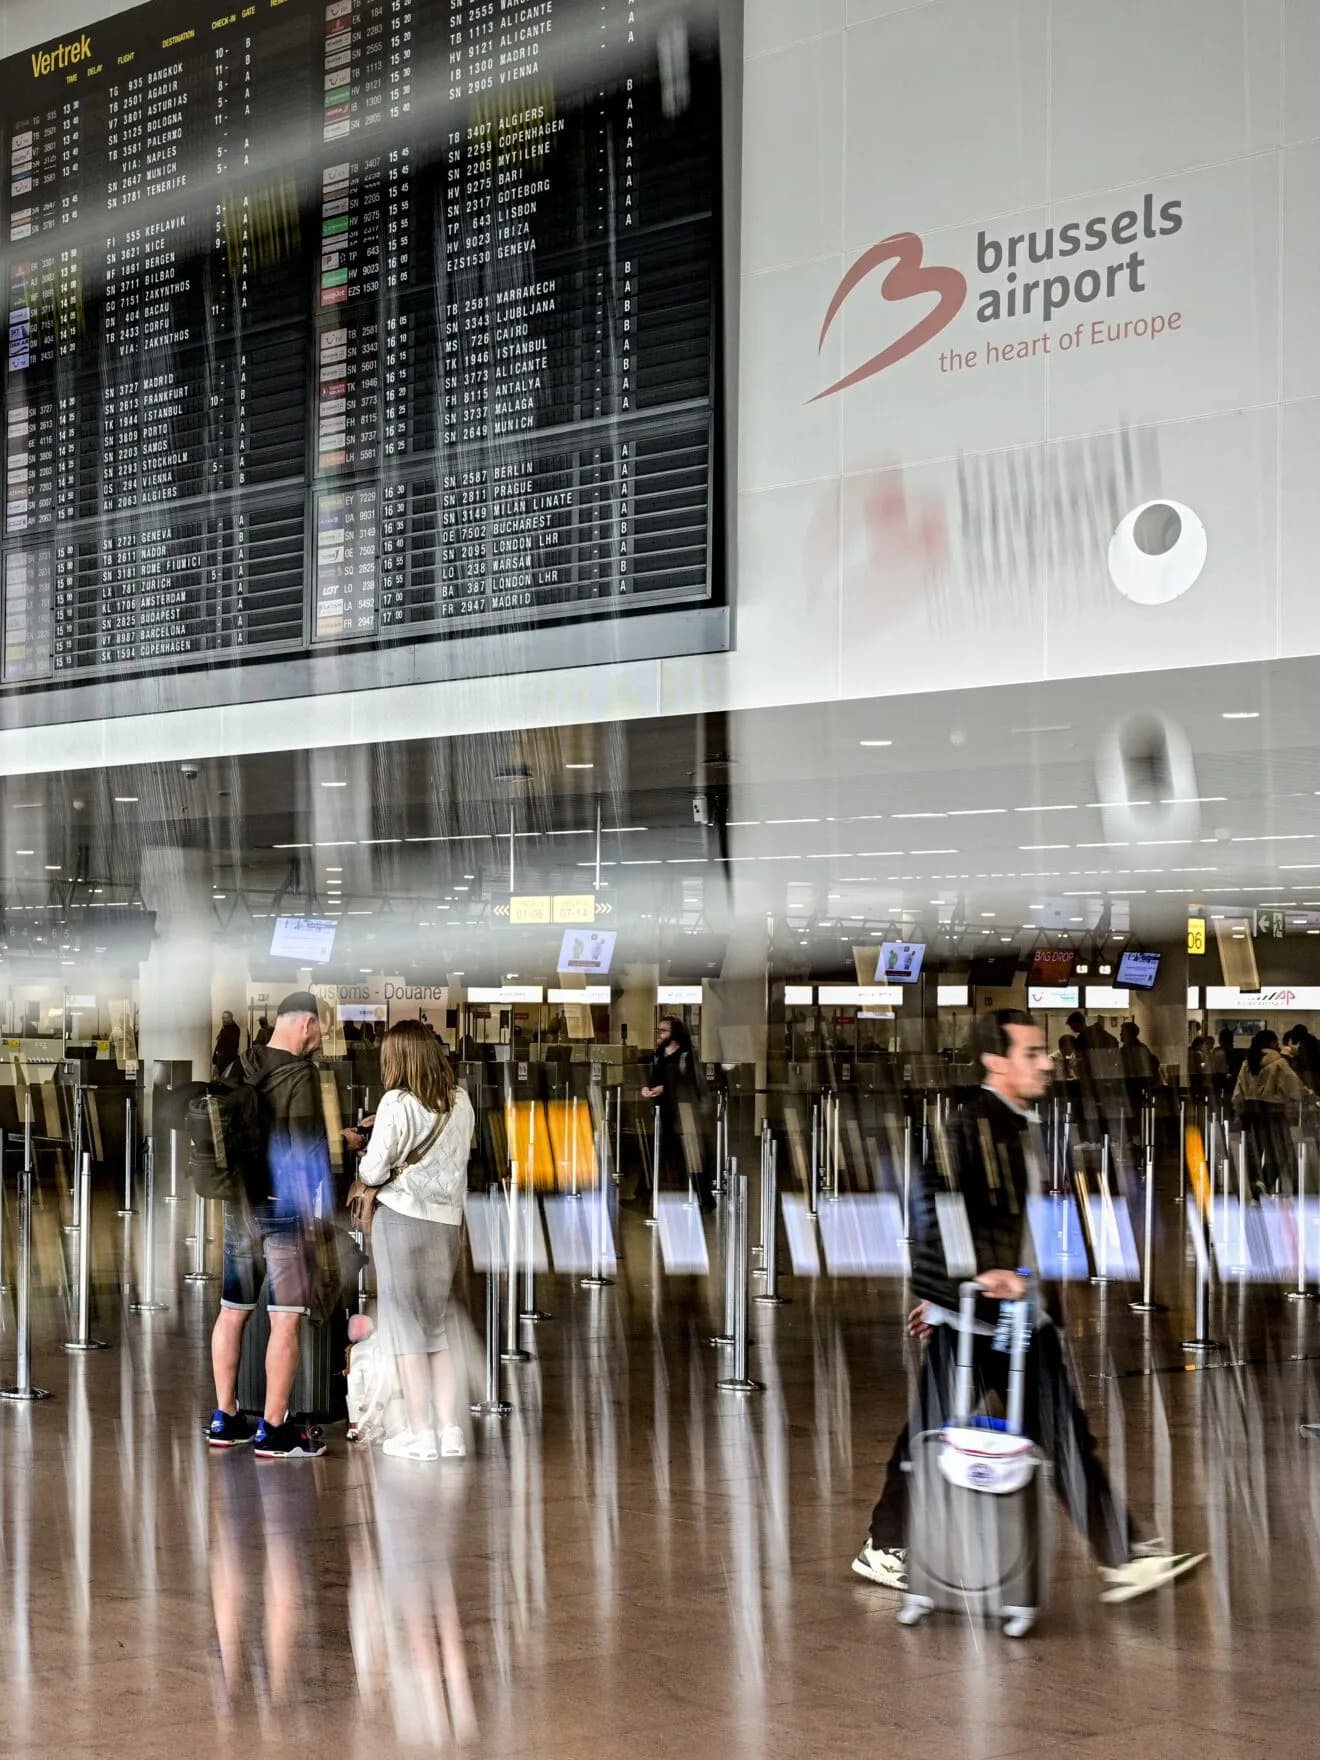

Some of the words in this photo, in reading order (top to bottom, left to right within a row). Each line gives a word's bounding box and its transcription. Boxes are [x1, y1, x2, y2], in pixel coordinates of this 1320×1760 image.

[500, 1, 552, 29] ALICANTE
[500, 20, 552, 48] ALICANTE
[32, 33, 91, 78] Vertrek
[66, 73, 77, 85] TIME
[87, 64, 103, 76] DELAY
[118, 52, 135, 65] FLIGHT
[162, 29, 195, 48] DESTINATION
[212, 14, 236, 30] CHECK-IN
[242, 6, 256, 19] GATE
[500, 43, 539, 66] MADRID
[148, 62, 183, 84] BANGKOK
[499, 61, 538, 85] VIENNA
[148, 81, 178, 99] AGADIR
[147, 93, 187, 116] ASTURIAS
[147, 113, 183, 132] BOLOGNA
[499, 105, 544, 131] ALGIERS
[147, 129, 182, 148] PALERMO
[499, 118, 565, 148] COPENHAGEN
[122, 154, 141, 173] VIA:
[147, 145, 177, 165] NAPLES
[498, 141, 550, 168] MYTILENE
[147, 162, 177, 180] MUNICH
[498, 171, 522, 186] BARI
[146, 175, 186, 197] TENERIFE
[498, 179, 550, 205] GOTEBORG
[498, 201, 536, 223] LISBON
[145, 216, 185, 236] KEFLAVIK
[498, 221, 529, 239] IBIZA
[977, 194, 1184, 274] brussels
[145, 238, 165, 253] NICE
[497, 239, 536, 260] GENEVA
[145, 251, 175, 269] BERGEN
[145, 268, 175, 285] BILBAO
[145, 279, 190, 302] ZAKYNTHOS
[497, 280, 555, 304] MARRAKECH
[976, 251, 1145, 324] airport
[145, 302, 169, 318] BACAU
[497, 298, 555, 323] LJUBLJANA
[145, 318, 169, 334] CORFU
[497, 323, 528, 341] CAIRO
[120, 342, 138, 356] VIA:
[144, 328, 189, 350] ZAKYNTHOS
[496, 337, 547, 359] ISTANBUL
[938, 348, 978, 373] the
[986, 333, 1050, 366] heart
[1058, 324, 1084, 351] of
[1091, 311, 1182, 345] Europe
[496, 356, 547, 379] ALICANTE
[144, 373, 174, 390] MADRID
[495, 377, 541, 397] ANTALYA
[144, 386, 189, 406] FRANKFURT
[144, 404, 183, 422] ISTANBUL
[495, 397, 533, 416] MALAGA
[143, 424, 168, 439] PORTO
[495, 415, 533, 433] MUNICH
[143, 439, 168, 455] SAMOS
[143, 452, 188, 471] STOCKHOLM
[143, 471, 172, 487] VIENNA
[444, 476, 456, 489] SN
[463, 470, 487, 485] 2587
[495, 461, 533, 479] BERLIN
[142, 486, 177, 503] ALGIERS
[443, 494, 455, 507] SN
[462, 489, 486, 503] 2811
[494, 480, 532, 498] PRAGUE
[443, 513, 455, 525] SN
[462, 507, 486, 522] 3149
[493, 501, 526, 517] MILAN
[533, 492, 572, 511] LINATE
[142, 528, 172, 544] GENEVA
[443, 531, 454, 544] OE
[462, 526, 486, 540] 7502
[493, 515, 551, 535] BUCHAREST
[142, 545, 166, 559] NADOR
[442, 548, 454, 561] SN
[462, 544, 486, 558] 2095
[493, 536, 531, 553] LONDON
[539, 533, 558, 546] LHR
[141, 563, 161, 576] ROME
[167, 555, 201, 572] FIUMICI
[493, 554, 531, 571] WARSAW
[141, 577, 171, 593] ZURICH
[492, 573, 531, 590] LONDON
[538, 570, 557, 584] LHR
[141, 591, 185, 609] AMSTERDAM
[492, 591, 531, 608] MADRID
[141, 609, 180, 624] BUDAPEST
[140, 624, 185, 641] BARCELONA
[140, 639, 190, 657] COPENHAGEN
[1188, 933, 1202, 948] 06
[1035, 950, 1051, 961] BAG
[1052, 951, 1073, 962] DROP
[308, 983, 369, 1000] Customs
[384, 982, 441, 1000] Douane
